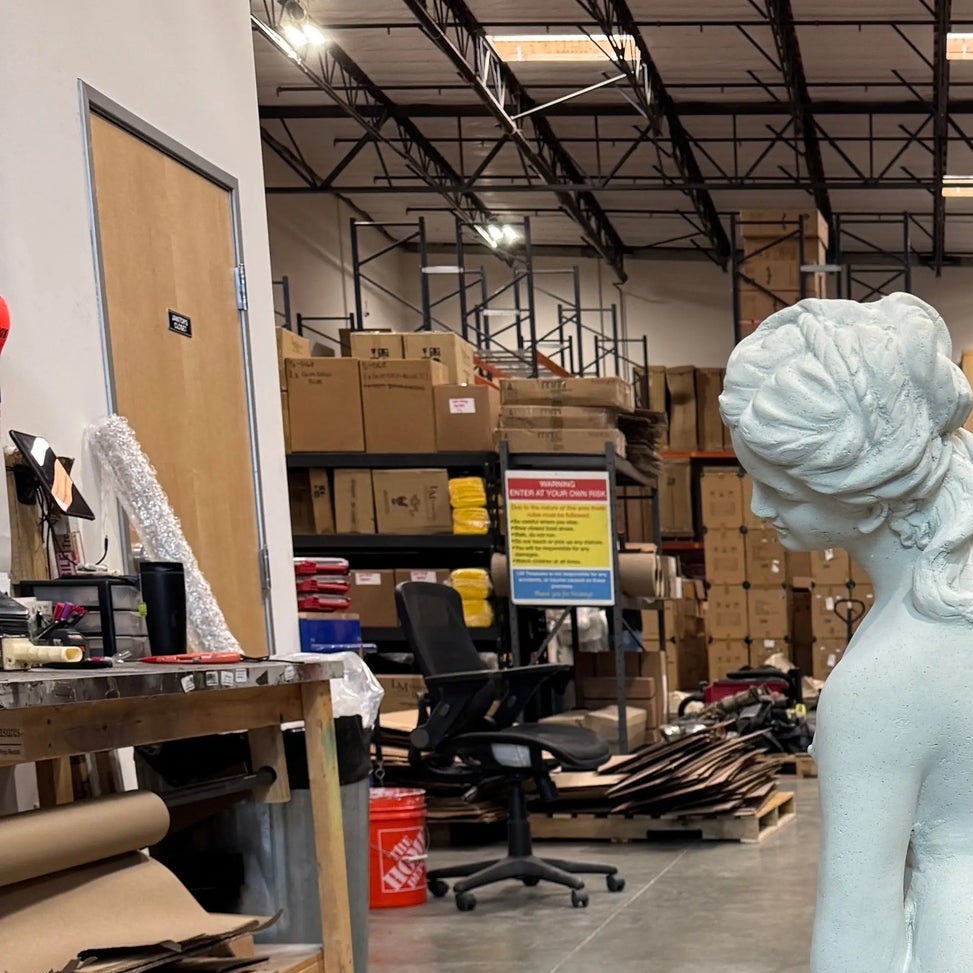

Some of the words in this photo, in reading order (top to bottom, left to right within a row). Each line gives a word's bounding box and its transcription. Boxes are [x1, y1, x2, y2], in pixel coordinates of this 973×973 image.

[539, 480, 576, 488] WARNING
[510, 489, 534, 497] ENTER
[536, 489, 545, 497] AT
[569, 490, 588, 498] OWN
[390, 835, 412, 858] THE
